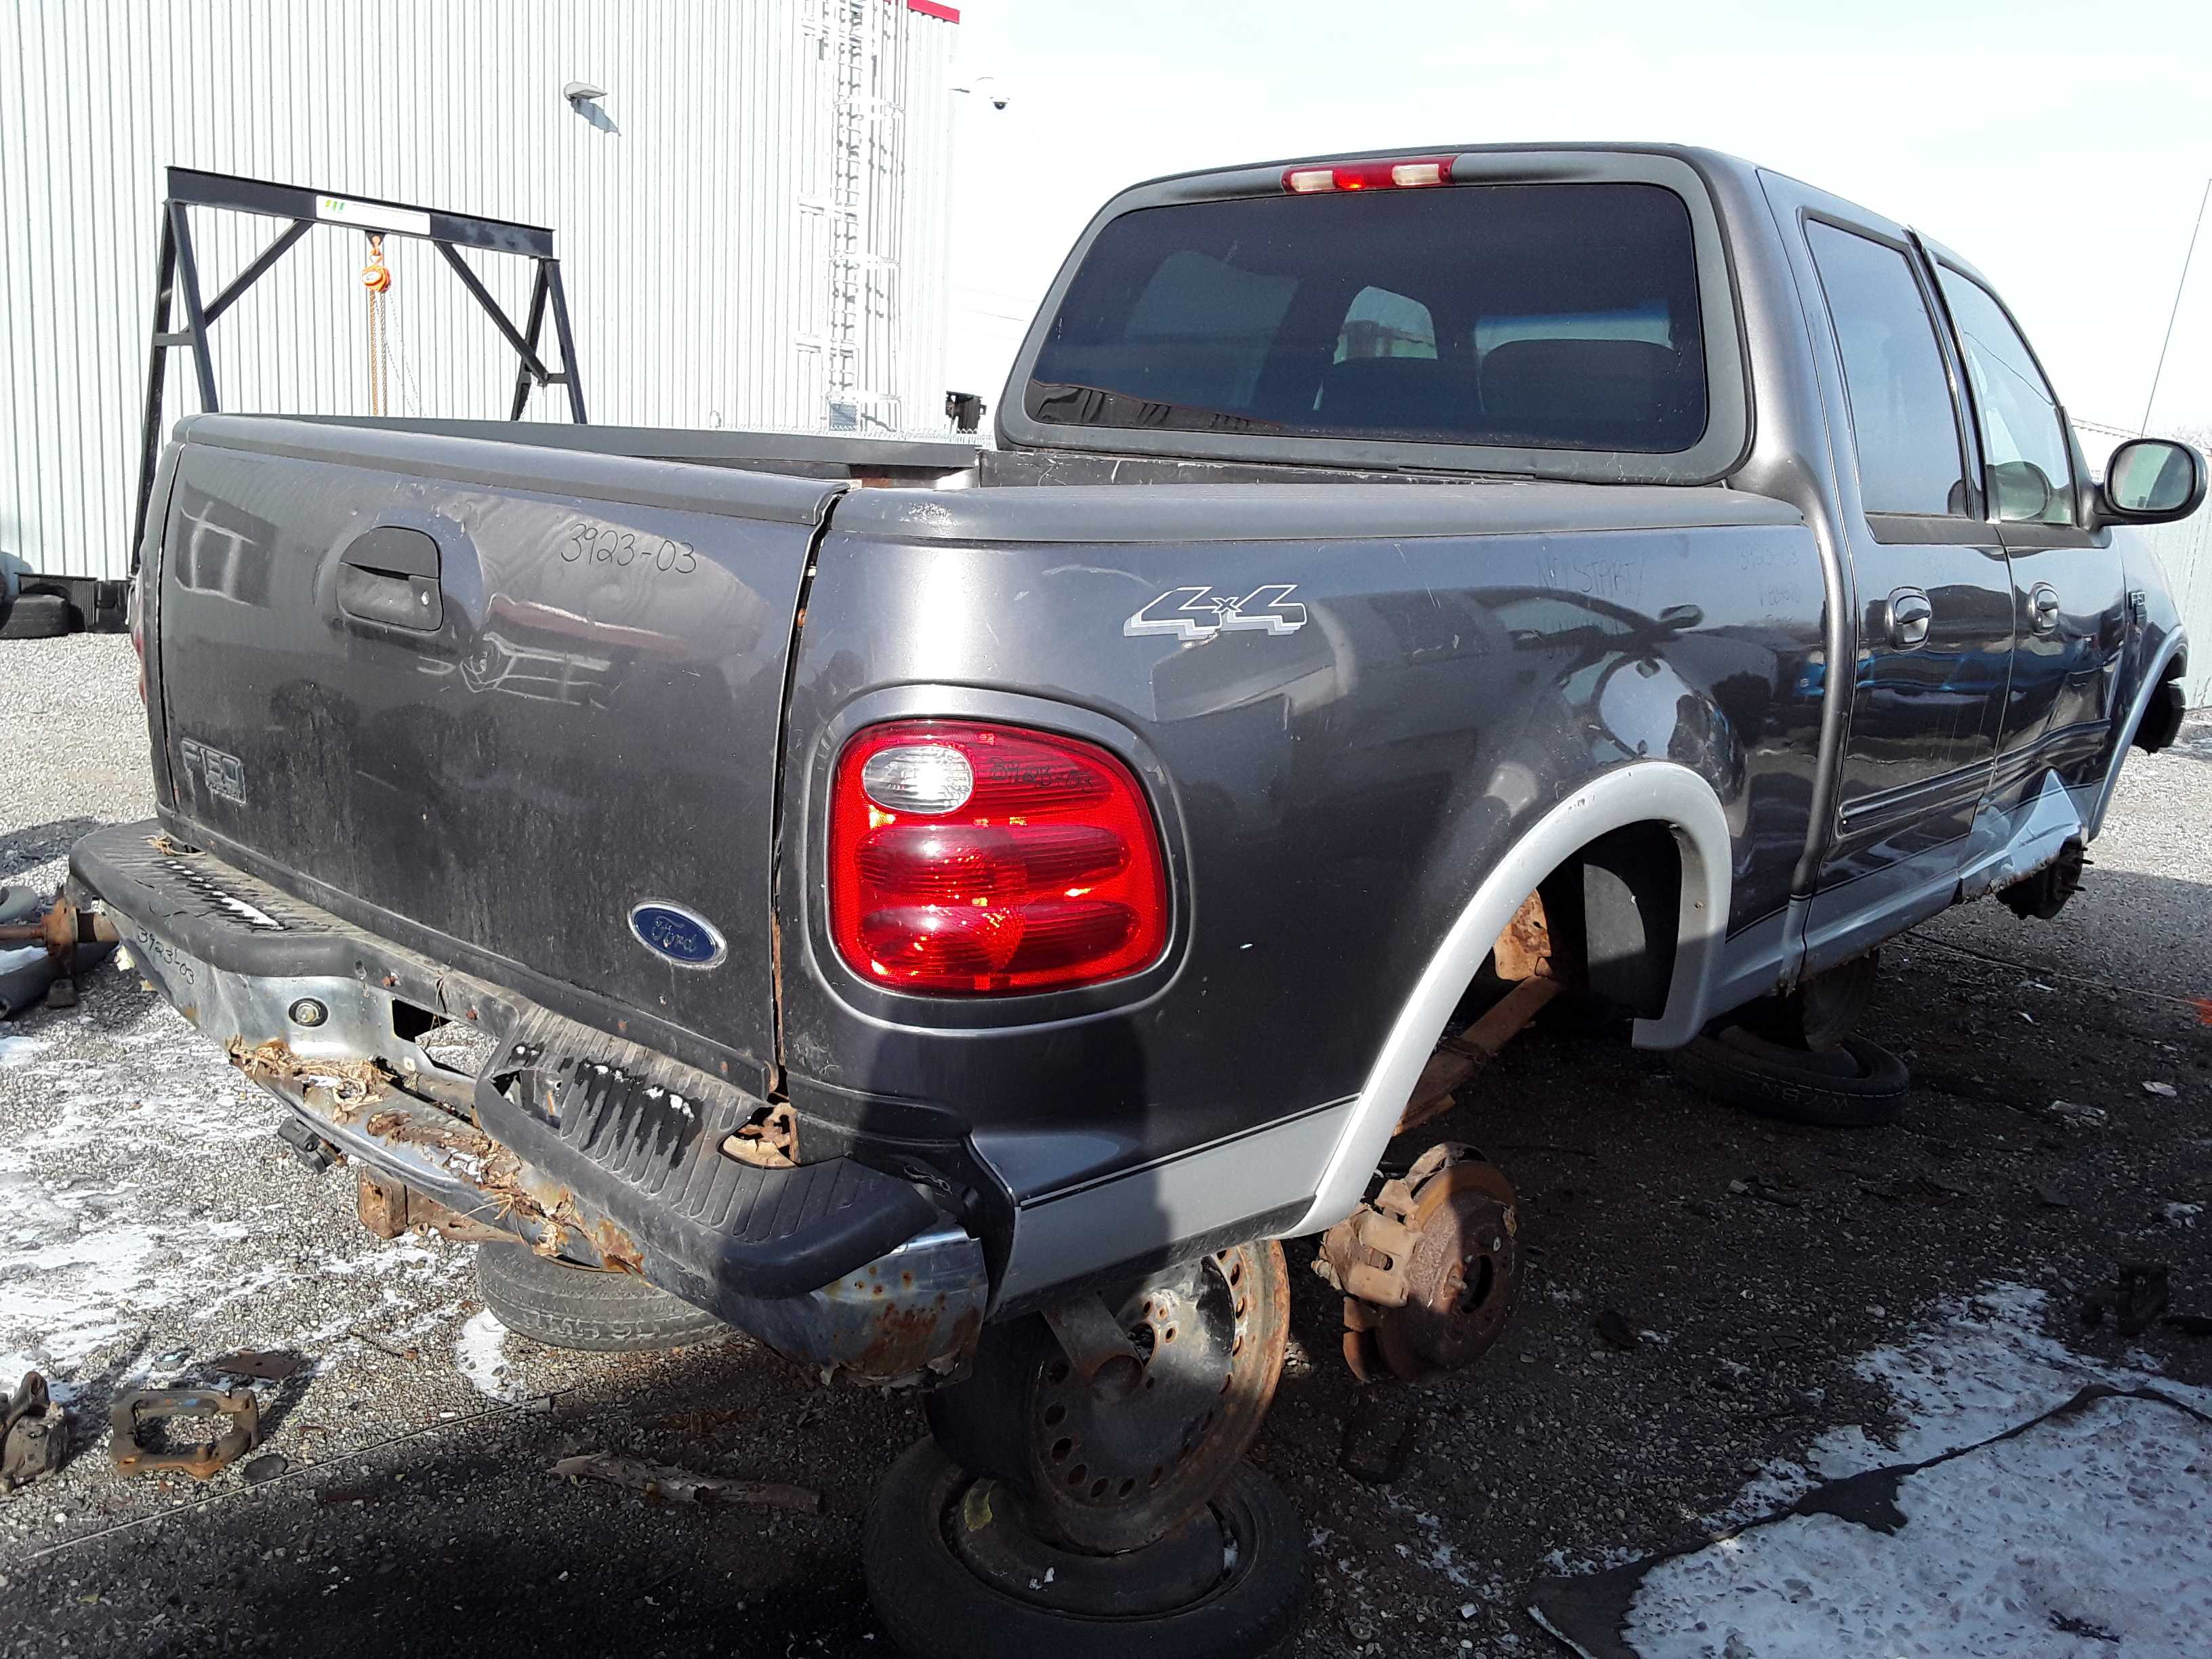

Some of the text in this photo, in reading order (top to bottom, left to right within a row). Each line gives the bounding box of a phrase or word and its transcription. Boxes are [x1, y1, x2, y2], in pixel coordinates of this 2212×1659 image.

[560, 523, 696, 573] 3923-03
[138, 924, 195, 985] 3923-03
[651, 915, 697, 954] Ford
